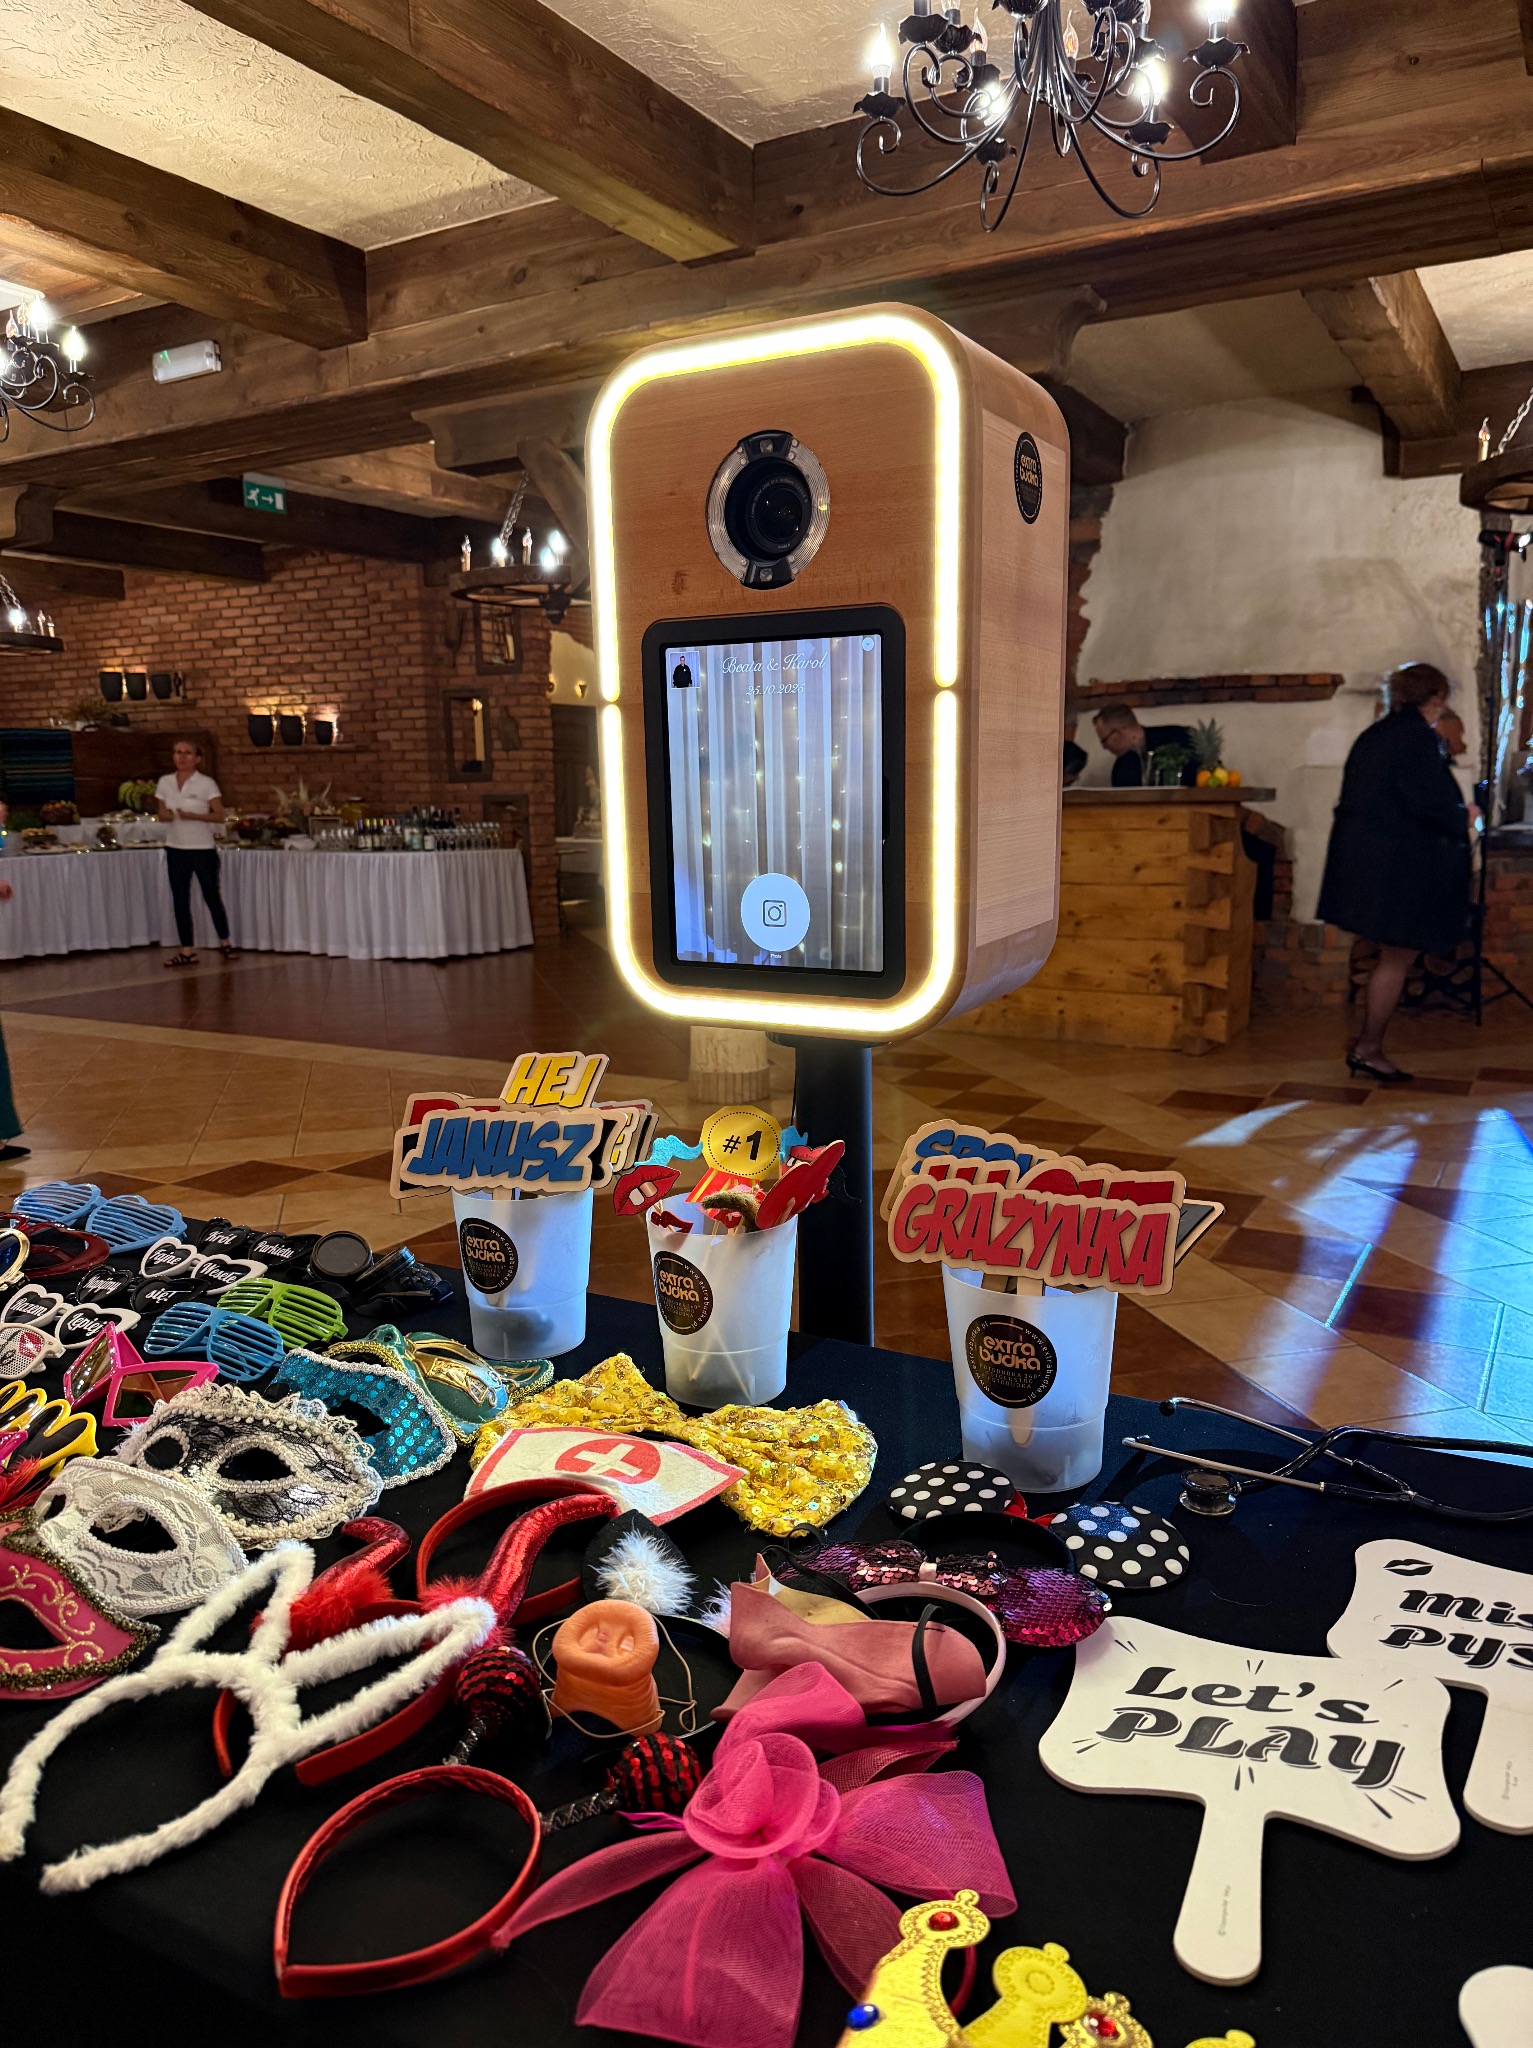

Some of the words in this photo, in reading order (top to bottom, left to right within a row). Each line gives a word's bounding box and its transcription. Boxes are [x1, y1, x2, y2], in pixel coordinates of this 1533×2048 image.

[722, 656, 763, 674] Beata
[766, 658, 781, 671] &
[782, 651, 829, 671] Karol
[746, 683, 806, 696] 25.10.2025
[505, 1055, 603, 1108] HEJ
[406, 1116, 596, 1183] JANUSZ
[722, 1130, 762, 1161] #1
[204, 1230, 238, 1245] Król
[253, 1240, 295, 1259] Parkietu
[466, 1235, 501, 1251] extra
[893, 1182, 1171, 1287] GRAŻYNKA
[149, 1248, 182, 1265] Fajne
[199, 1262, 238, 1284] Wesele
[465, 1244, 506, 1263] budka
[658, 1278, 700, 1303] budka
[659, 1269, 695, 1290] extra
[10, 1297, 48, 1317] Razem
[67, 1312, 108, 1337] Lepiej
[979, 1345, 1041, 1371] budka
[983, 1335, 1037, 1357] extra
[1125, 1666, 1380, 1724] Let's
[1096, 1706, 1406, 1789] PLAY
